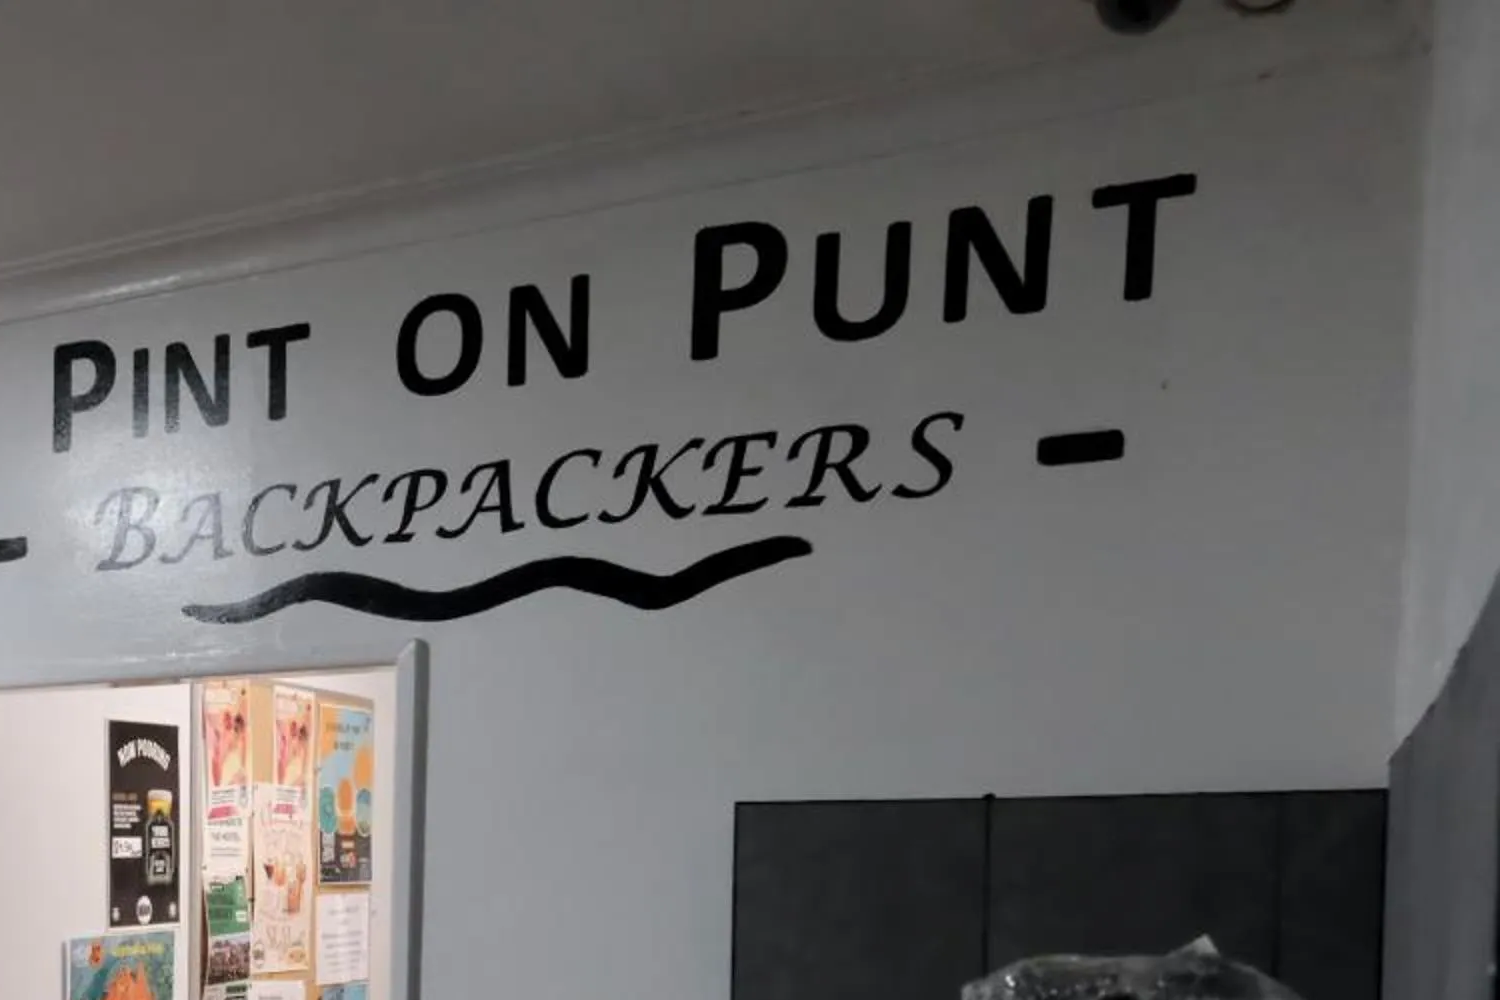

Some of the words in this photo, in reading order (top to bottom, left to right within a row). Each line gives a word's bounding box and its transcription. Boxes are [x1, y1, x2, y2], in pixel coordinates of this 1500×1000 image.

[52, 322, 311, 453] PINT
[396, 273, 590, 397] ON
[690, 172, 1197, 361] PUNT
[94, 411, 965, 572] BACKPACKERS
